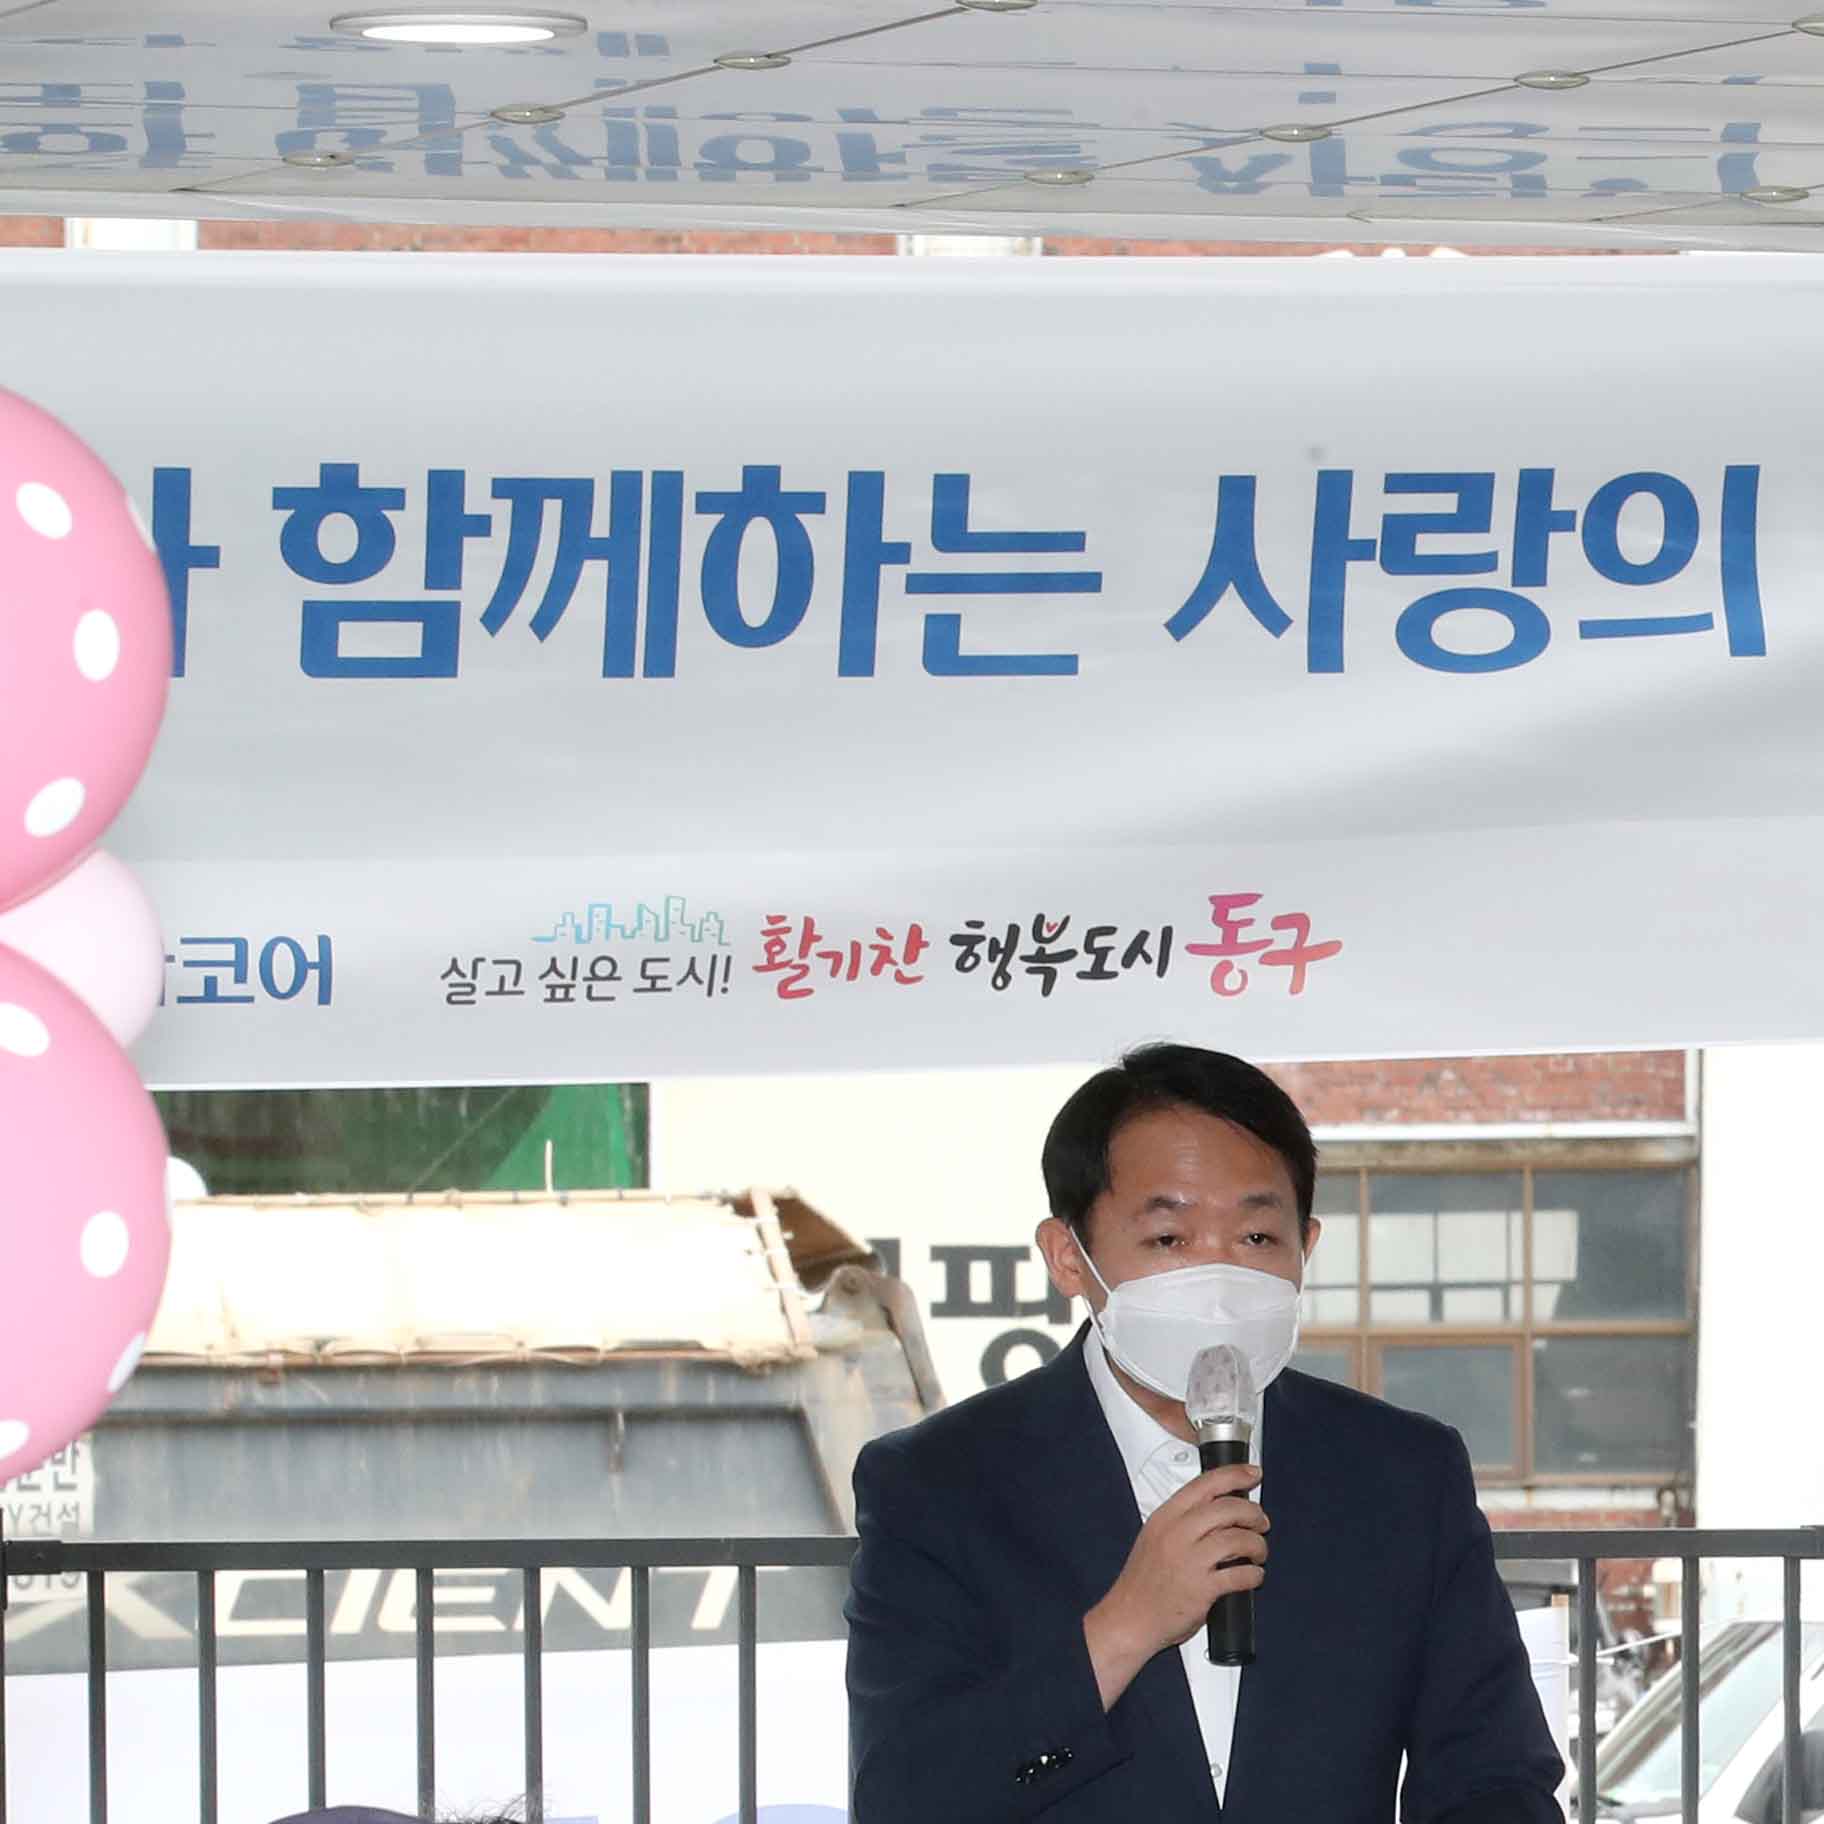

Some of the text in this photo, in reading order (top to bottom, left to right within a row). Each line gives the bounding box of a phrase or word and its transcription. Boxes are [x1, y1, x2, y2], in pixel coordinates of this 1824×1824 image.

[272, 464, 1102, 678] 함께하는
[1165, 465, 1766, 673] 사랑의
[160, 935, 334, 1006] 코어
[440, 892, 1342, 1005] 살고 싶은 도시! 활기찬 행복도시 동구
